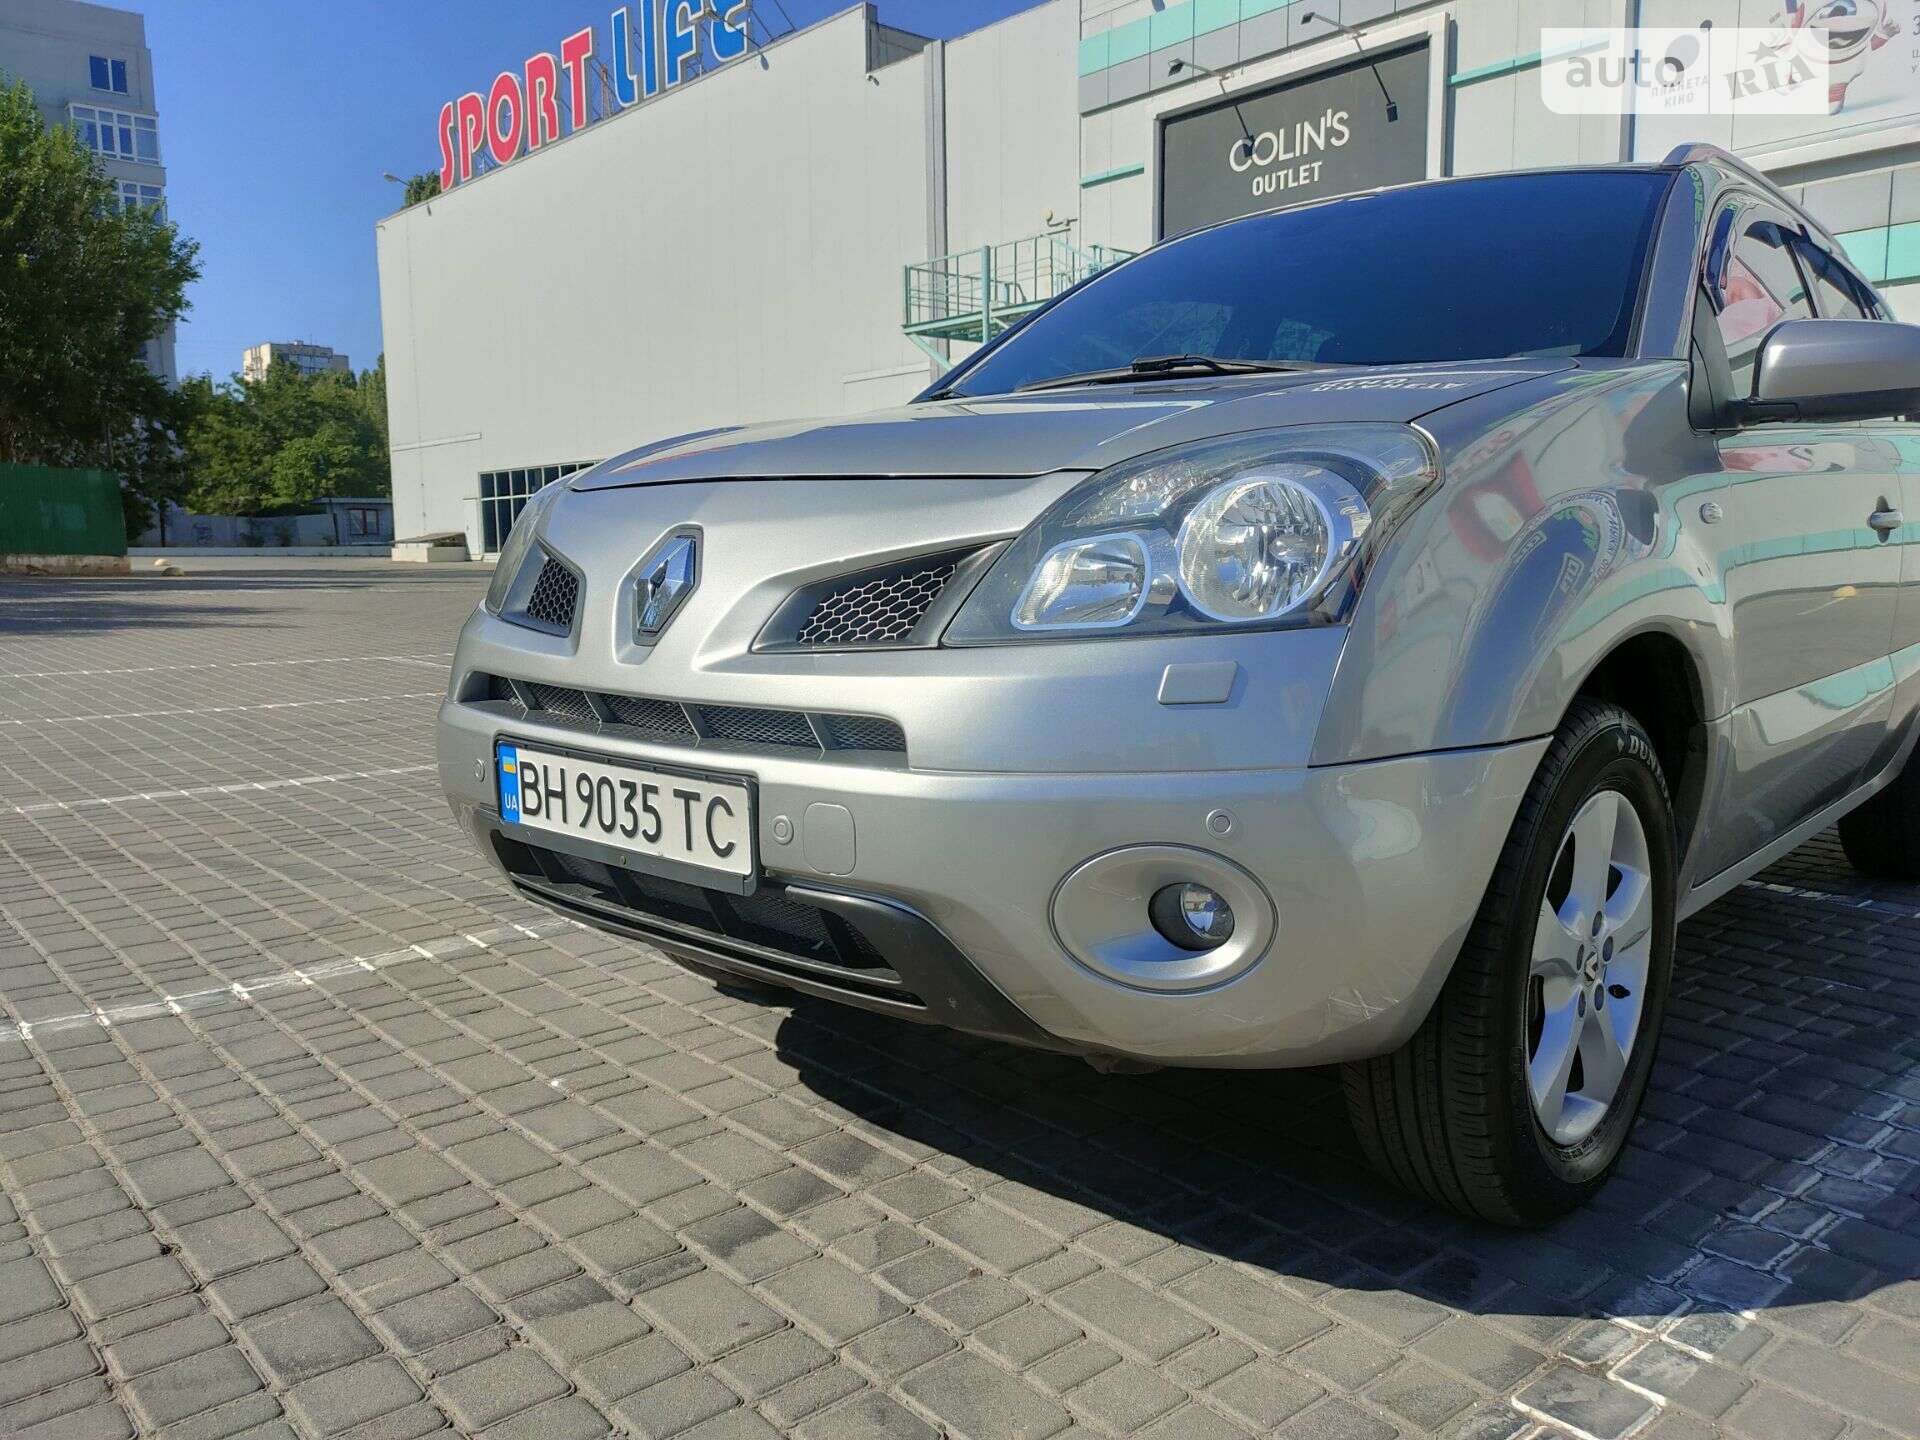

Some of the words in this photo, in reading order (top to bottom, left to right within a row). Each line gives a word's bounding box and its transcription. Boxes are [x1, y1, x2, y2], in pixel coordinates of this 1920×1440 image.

[439, 27, 592, 191] SPORT
[611, 0, 748, 108] LIFE
[1229, 108, 1350, 172] COLIN'S
[1252, 161, 1322, 196] OUTLET
[504, 794, 518, 811] UA
[519, 761, 567, 824] BH
[576, 772, 662, 843] 9035
[673, 787, 735, 858] TC
